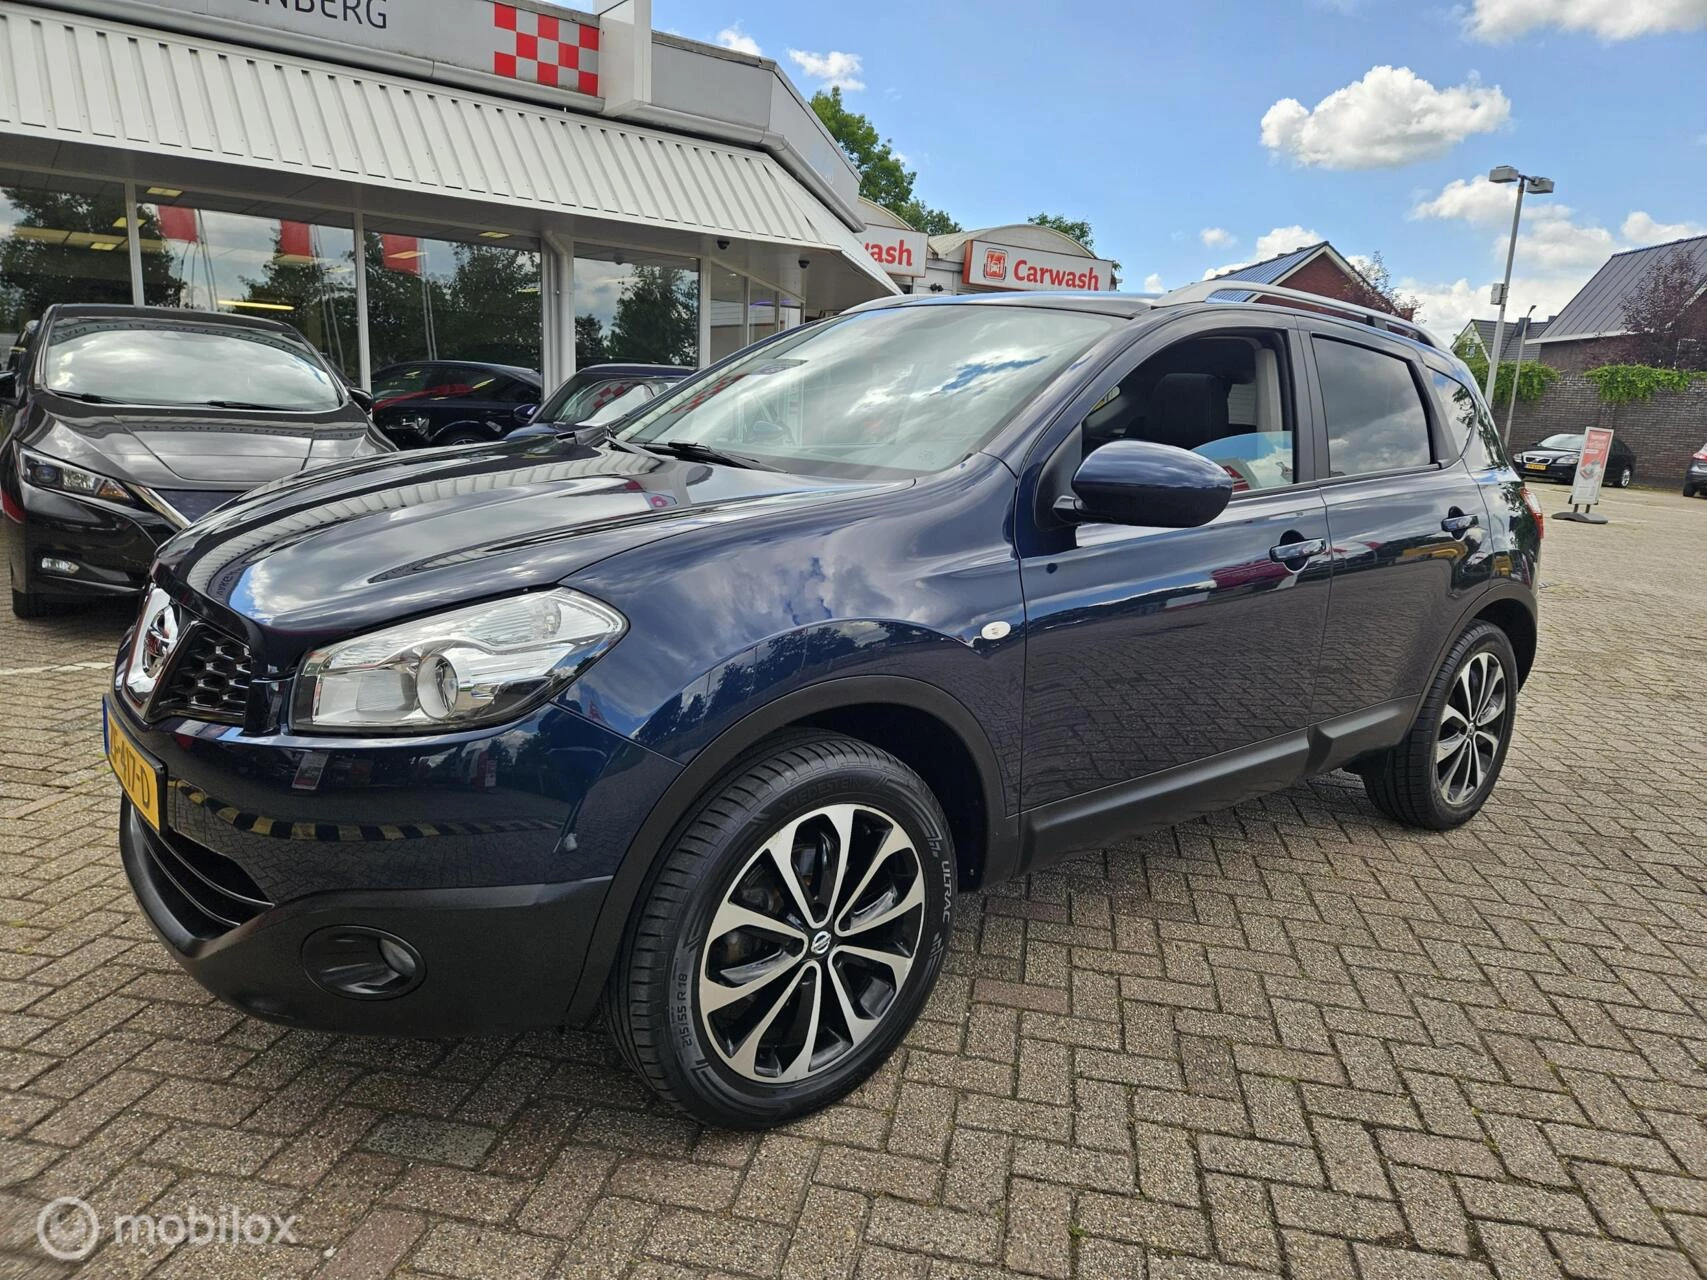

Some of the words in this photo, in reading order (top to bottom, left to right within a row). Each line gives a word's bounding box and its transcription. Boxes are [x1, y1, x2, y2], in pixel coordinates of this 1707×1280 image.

[247, 0, 387, 29] ERG
[865, 240, 912, 266] ash
[1013, 258, 1099, 291] Carwash
[941, 860, 952, 923] ULTRAC
[678, 973, 688, 987] 18
[677, 990, 687, 1001] R
